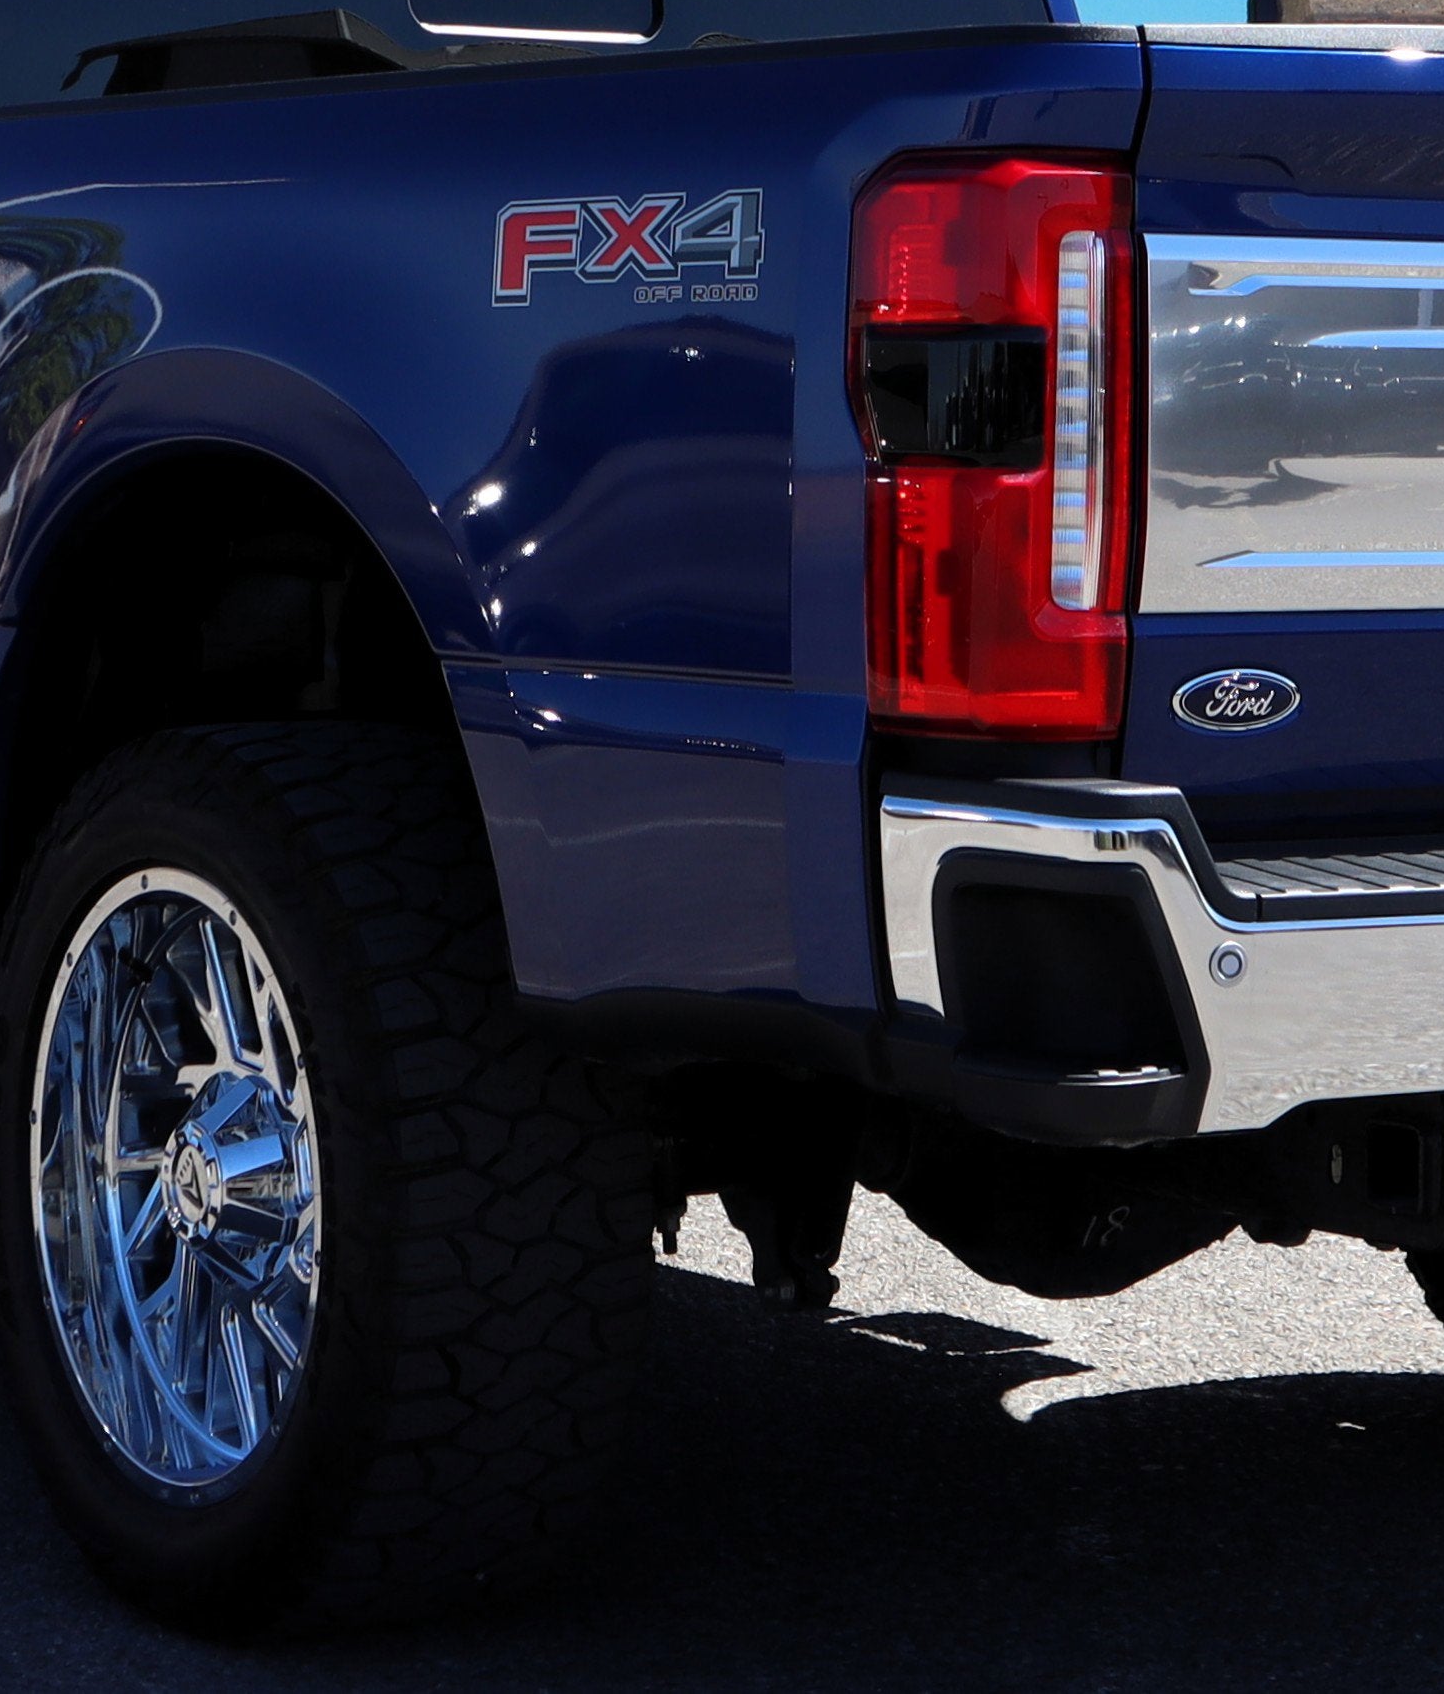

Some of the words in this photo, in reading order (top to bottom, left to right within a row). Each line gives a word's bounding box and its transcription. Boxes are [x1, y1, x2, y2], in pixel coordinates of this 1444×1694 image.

[491, 187, 765, 308] FX4
[634, 285, 683, 304] OFF
[690, 283, 759, 303] ROAD
[1205, 680, 1276, 718] Ford
